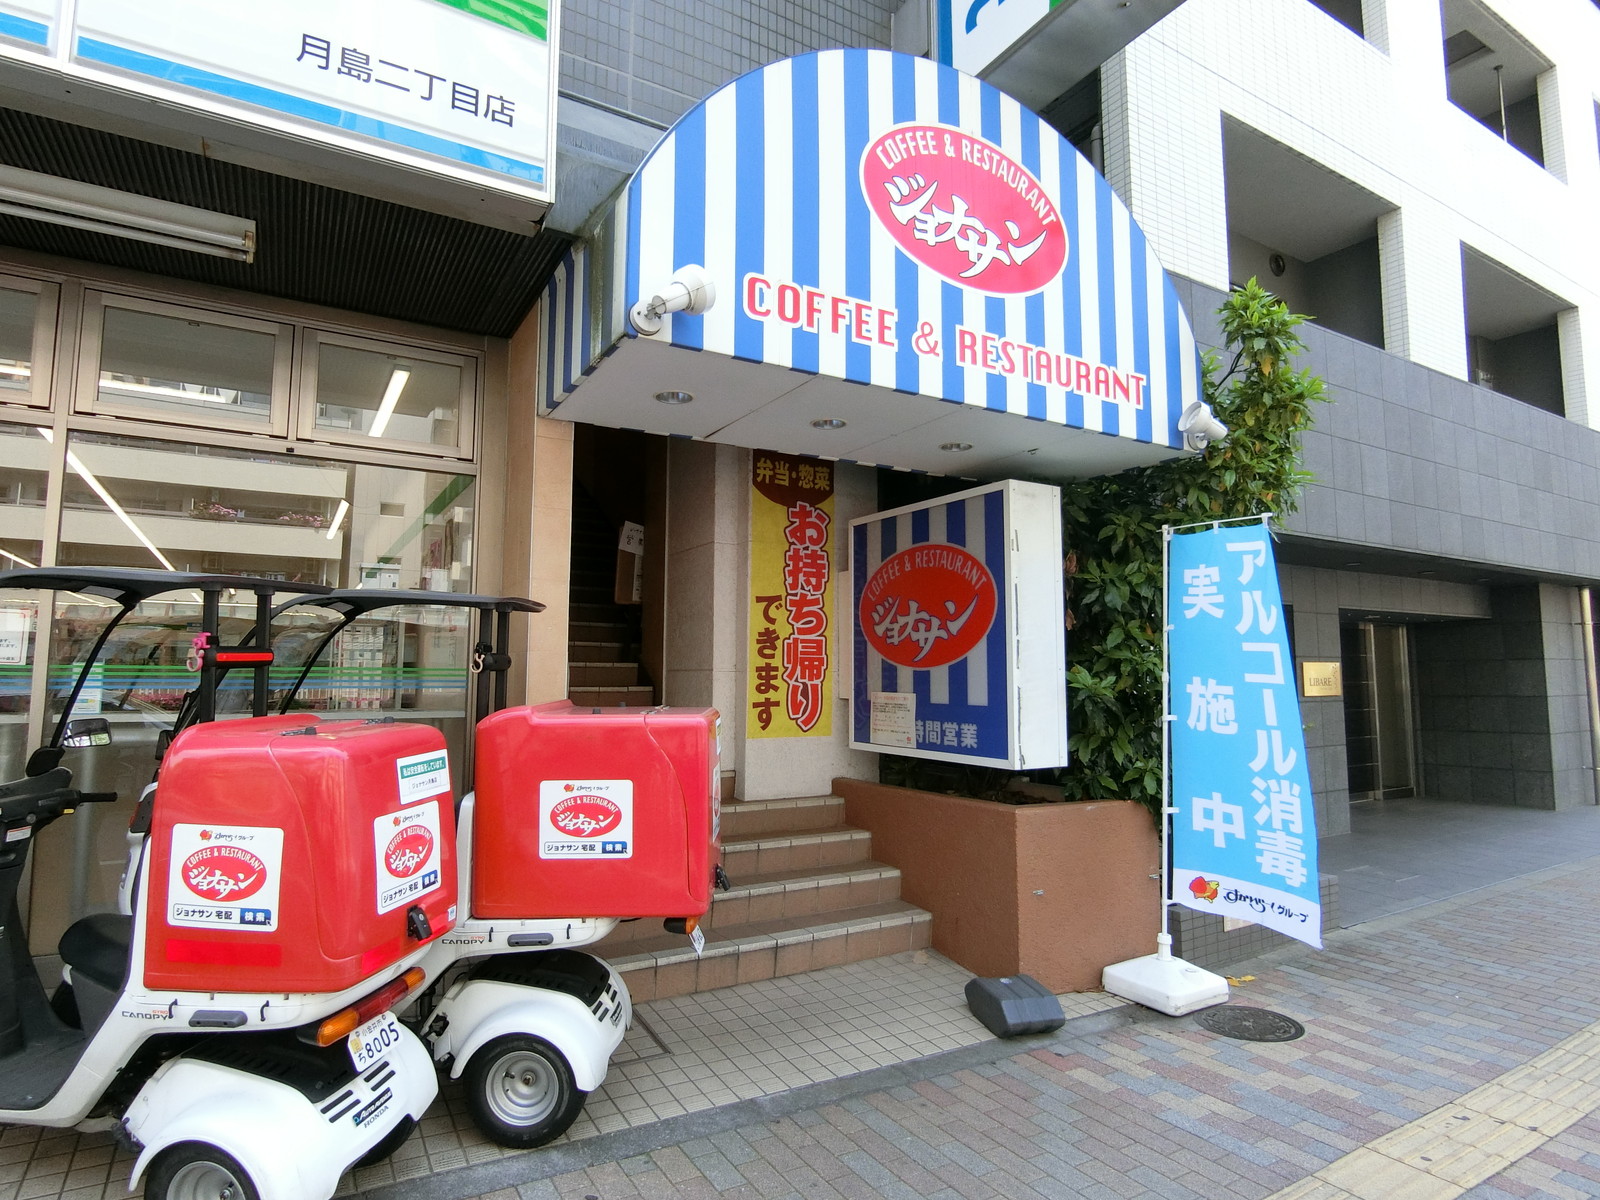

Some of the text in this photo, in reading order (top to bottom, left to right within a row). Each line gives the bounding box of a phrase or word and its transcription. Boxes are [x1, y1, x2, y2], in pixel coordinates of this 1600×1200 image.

[296, 33, 516, 128] 月島二丁目店
[876, 130, 1057, 226] COFFEE & RESTAURANT
[883, 172, 1048, 279] ジョナサン
[745, 276, 1146, 408] COFFEE & RESTAURANT
[756, 457, 831, 491] 弁当・惣菜
[867, 549, 988, 601] COFFEE & RESTAURANT
[783, 501, 829, 732] お持ち帰り
[871, 593, 979, 662] ジョナサン
[752, 594, 784, 731] できます
[1309, 677, 1333, 687] LIBARE
[1226, 540, 1308, 889] アルコール消毒
[554, 796, 619, 814] COFFEE & RESTAURANT
[387, 832, 403, 854] COFFEE
[407, 826, 432, 840] RESTAURANT
[556, 811, 615, 837] ジョナサン
[186, 847, 264, 872] COFFEE & RESTAURANT
[389, 842, 430, 875] ジョナサン
[547, 844, 580, 852] ジョナサン
[581, 844, 596, 852] 宅配
[188, 865, 258, 900] ジョナサン
[383, 886, 409, 904] ジョナサン
[408, 881, 419, 893] 宅配
[176, 907, 266, 922] ジョナサン 宅配 検索
[121, 1010, 169, 1021] CANOPY
[365, 1021, 400, 1059] 8005
[363, 1105, 390, 1129] HONDA
